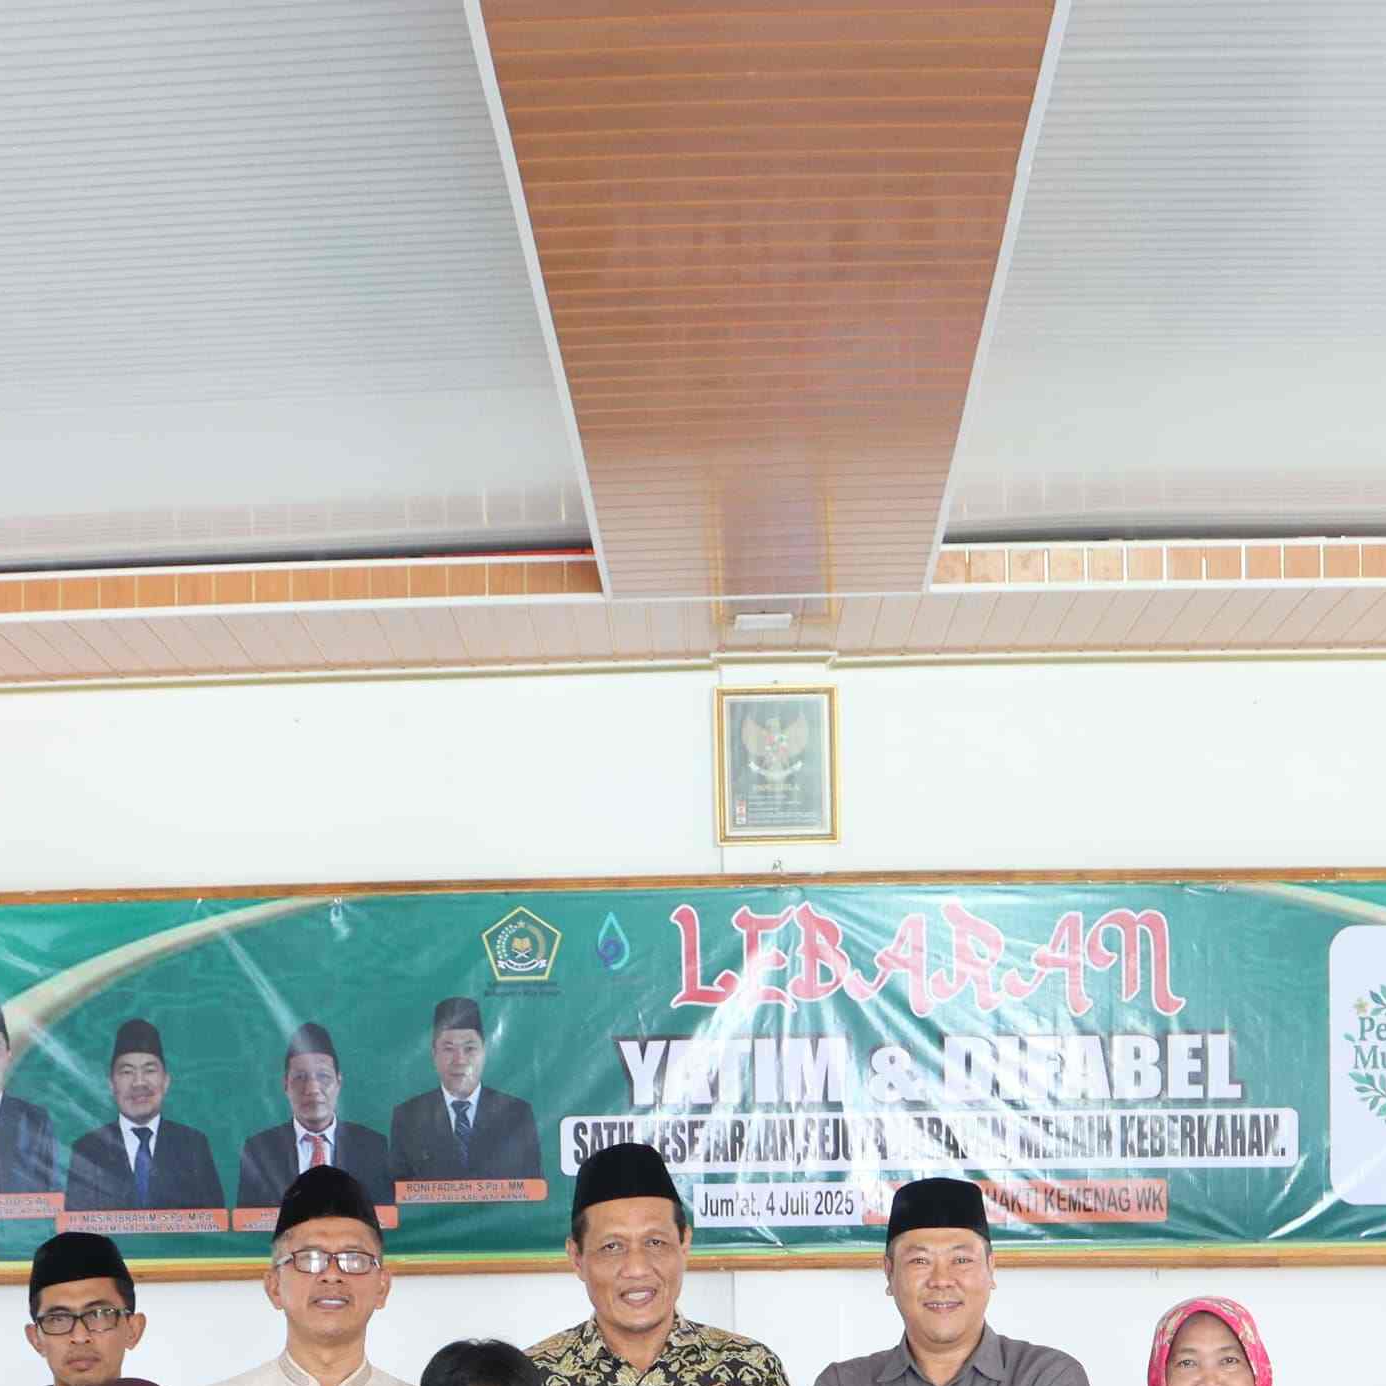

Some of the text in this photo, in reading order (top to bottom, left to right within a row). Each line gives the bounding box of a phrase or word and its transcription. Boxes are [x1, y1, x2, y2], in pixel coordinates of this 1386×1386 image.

[670, 898, 1186, 1017] LEBARAN
[619, 1033, 1243, 1104] YATIM & DIFABEL
[1119, 1113, 1287, 1158] KEBERKAHAN.
[766, 1190, 775, 1213] 4
[779, 1187, 809, 1215] Juli
[814, 1186, 854, 1215] 2025
[1044, 1186, 1131, 1213] KEMENAG
[1136, 1185, 1164, 1211] WK
